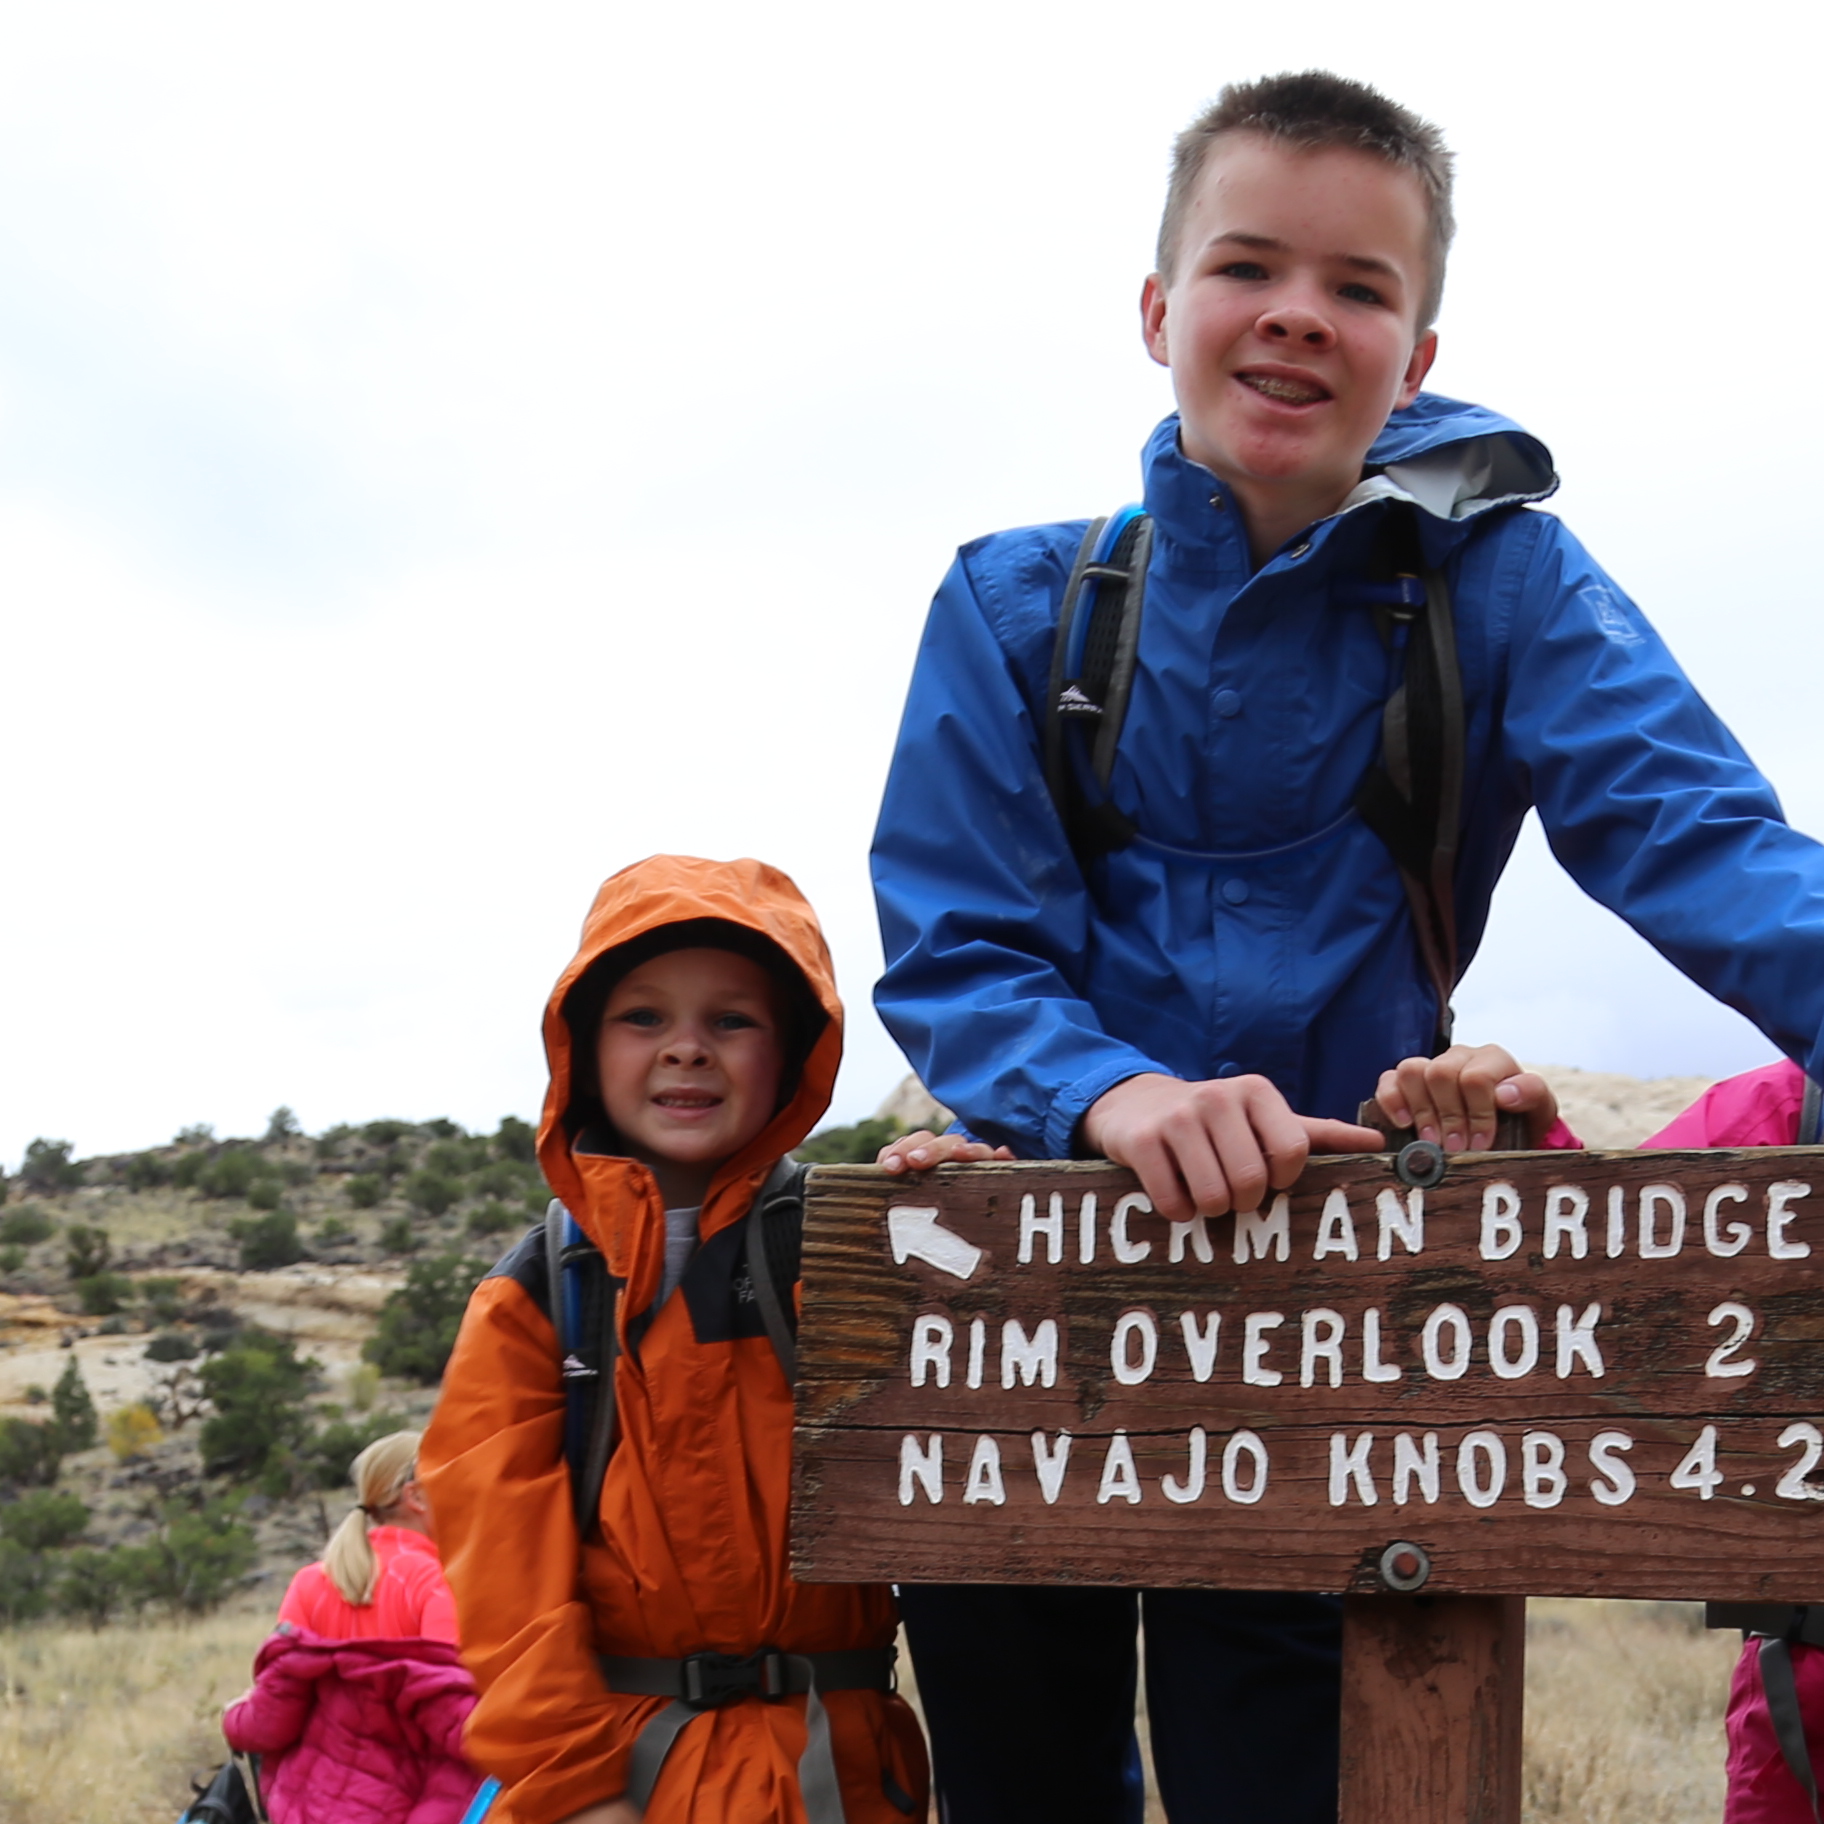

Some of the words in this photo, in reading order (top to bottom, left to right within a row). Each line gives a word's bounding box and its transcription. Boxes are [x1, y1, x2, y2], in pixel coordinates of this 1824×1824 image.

[1477, 1181, 1812, 1261] BRIDGE
[909, 1313, 1059, 1391] RIM
[1109, 1302, 1606, 1390] OVERLOOK
[1704, 1301, 1757, 1379] 2
[897, 1426, 1269, 1507] NAVAJO
[1327, 1430, 1637, 1509] KNOBS
